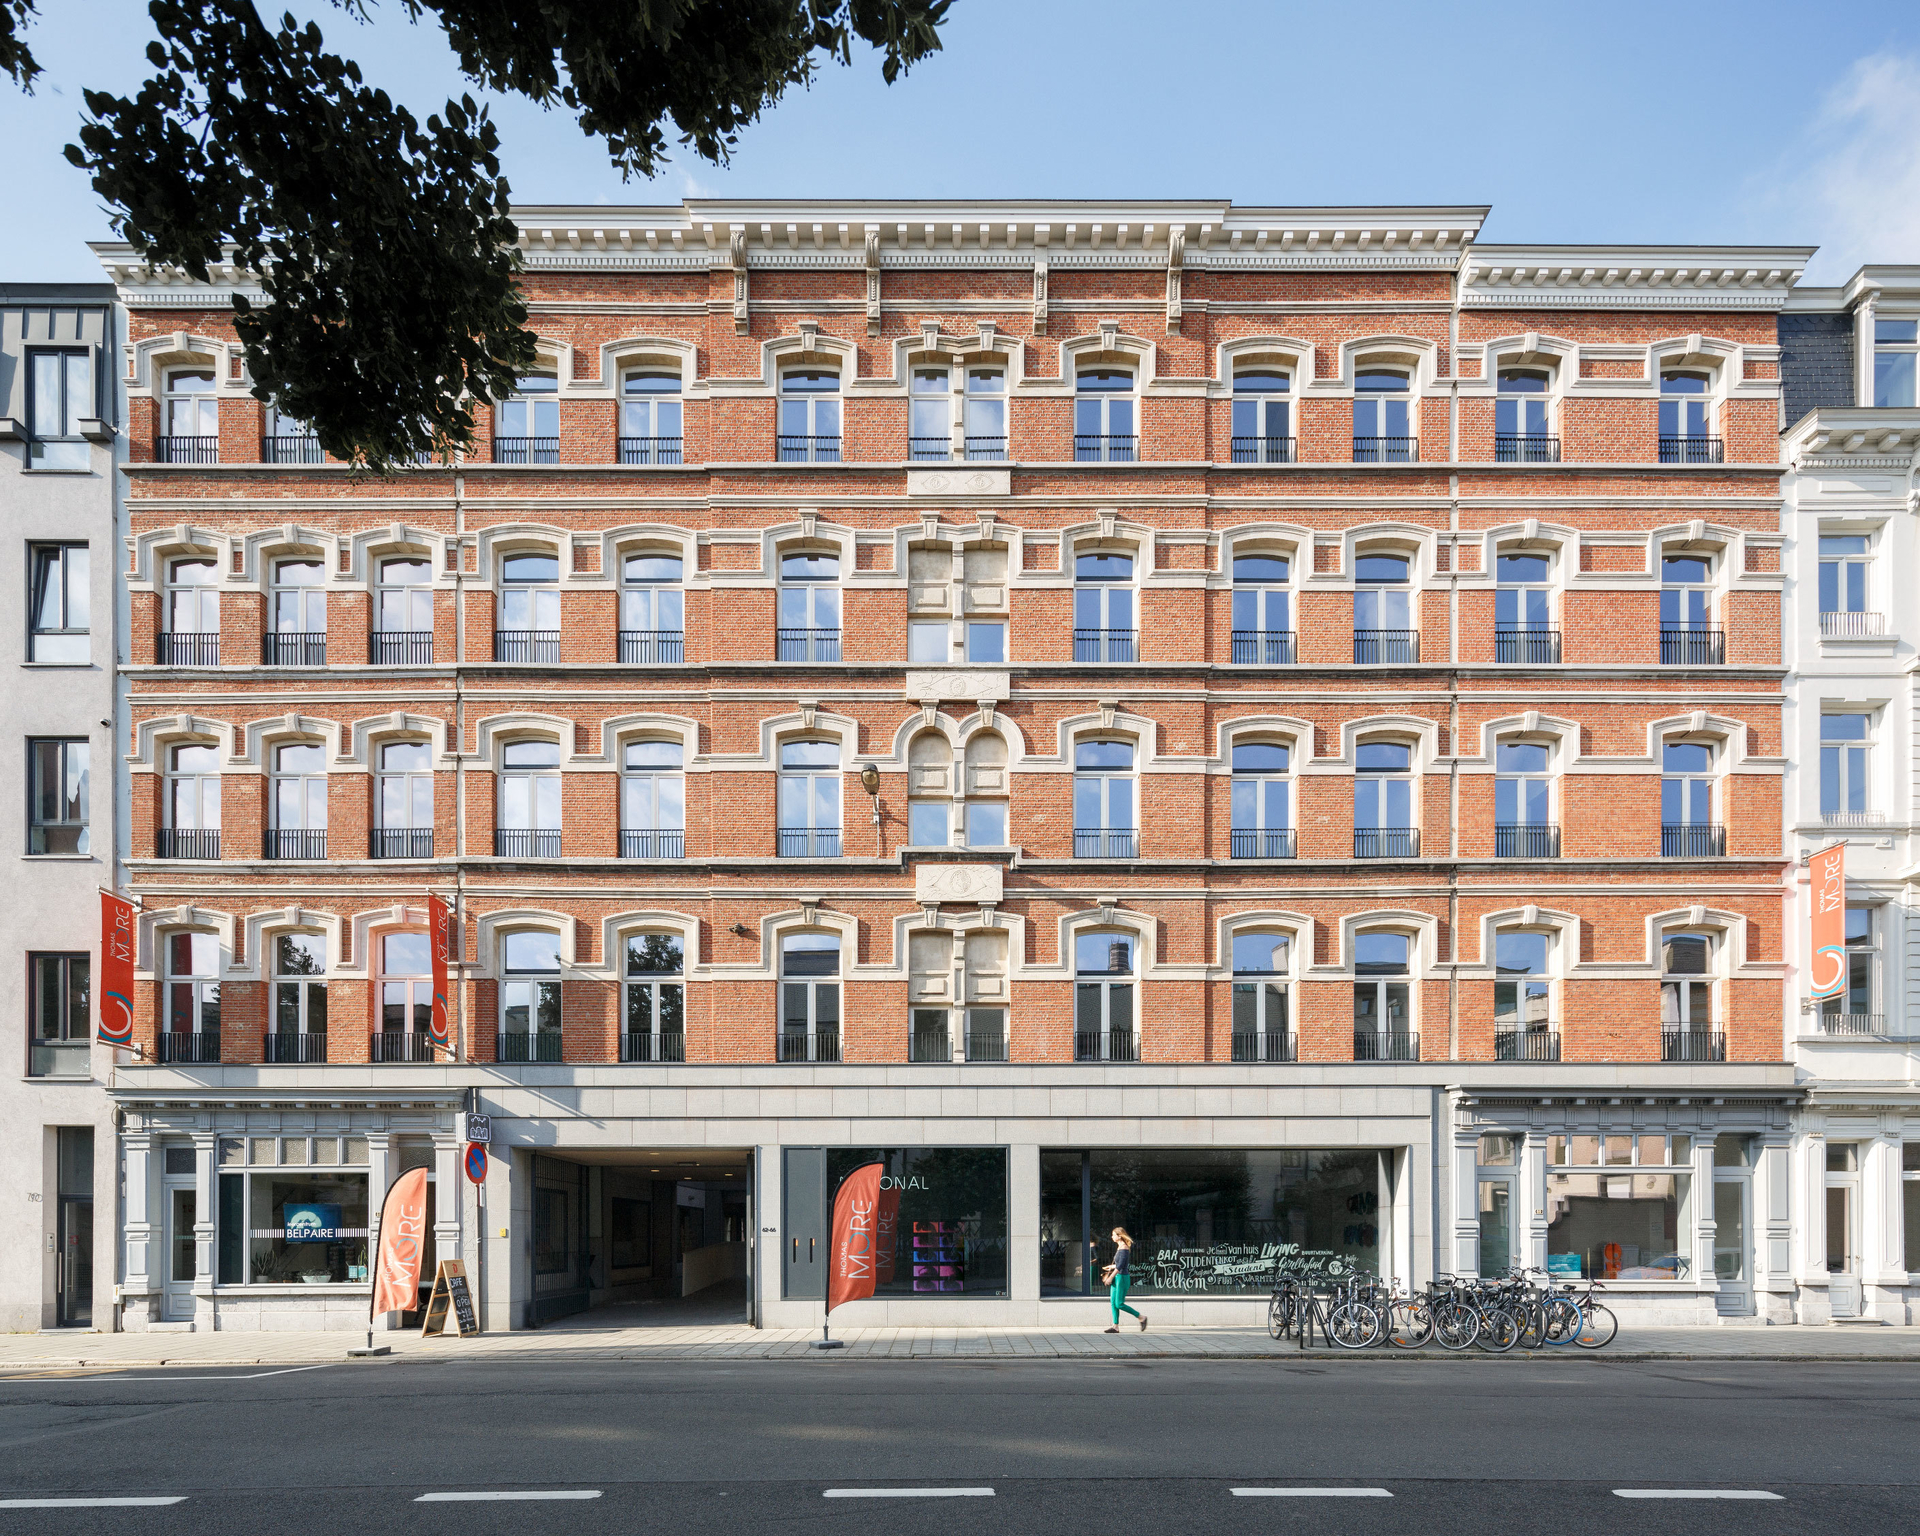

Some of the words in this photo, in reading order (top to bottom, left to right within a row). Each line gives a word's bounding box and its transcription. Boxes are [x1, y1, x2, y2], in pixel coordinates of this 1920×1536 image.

[1825, 854, 1840, 912] MORE
[116, 906, 129, 962] MORE
[437, 908, 447, 963] MORE
[286, 1228, 334, 1238] BELPAIRE
[392, 1204, 422, 1287] MORE
[848, 1200, 872, 1279] MORE
[1243, 1243, 1259, 1255] huis
[384, 1247, 394, 1283] THOMAS
[1157, 1249, 1178, 1260] BAR
[1180, 1255, 1237, 1270] STUDENTENKOT
[1225, 1262, 1263, 1274] Student
[1153, 1261, 1208, 1292] Welkom
